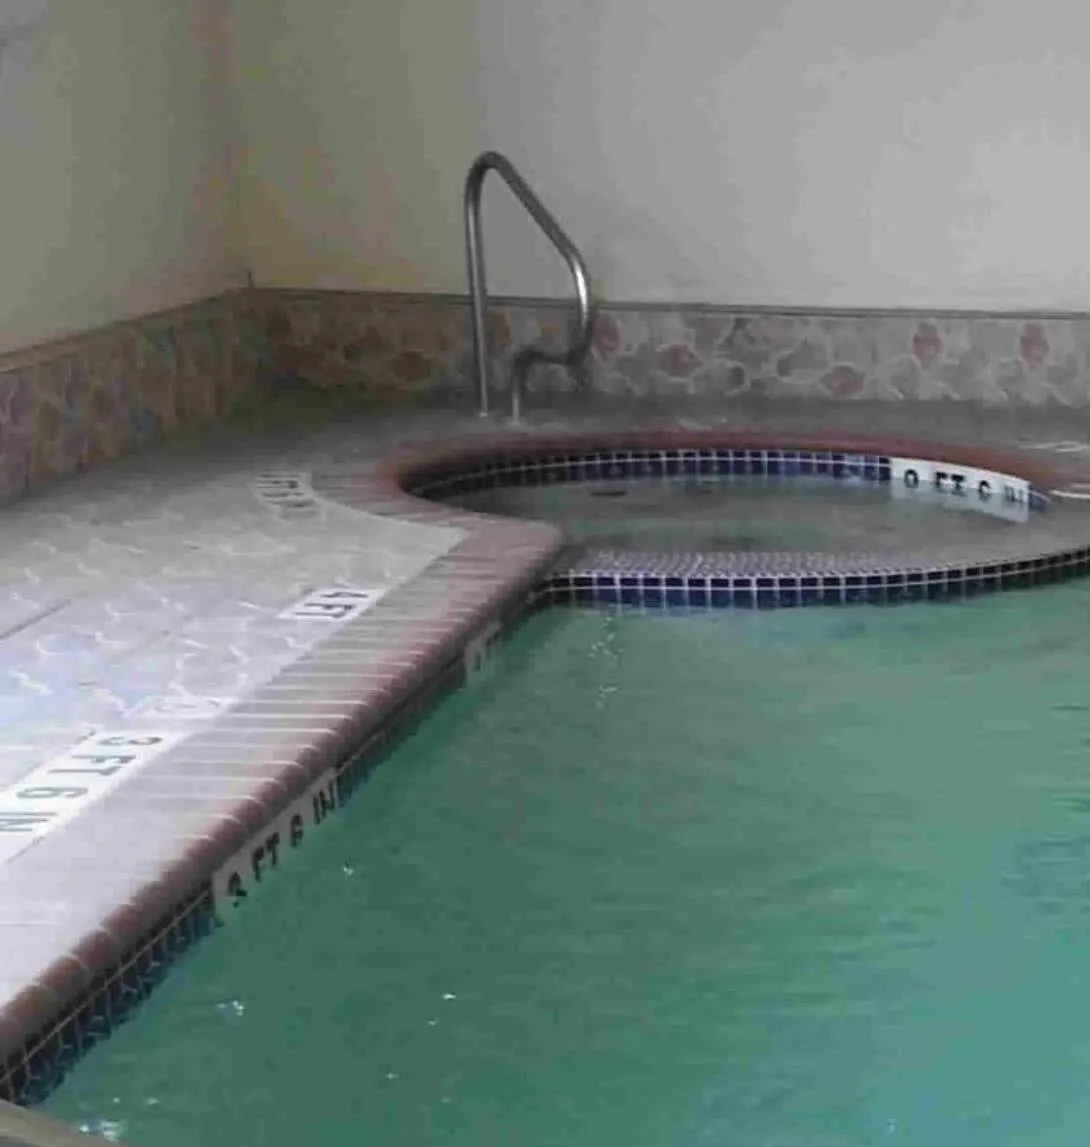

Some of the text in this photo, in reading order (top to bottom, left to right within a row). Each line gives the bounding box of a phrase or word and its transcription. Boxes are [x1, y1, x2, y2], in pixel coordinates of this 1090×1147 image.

[294, 602, 357, 619] FT
[95, 736, 164, 746] 3
[47, 753, 137, 776] FT
[15, 786, 89, 799] 6
